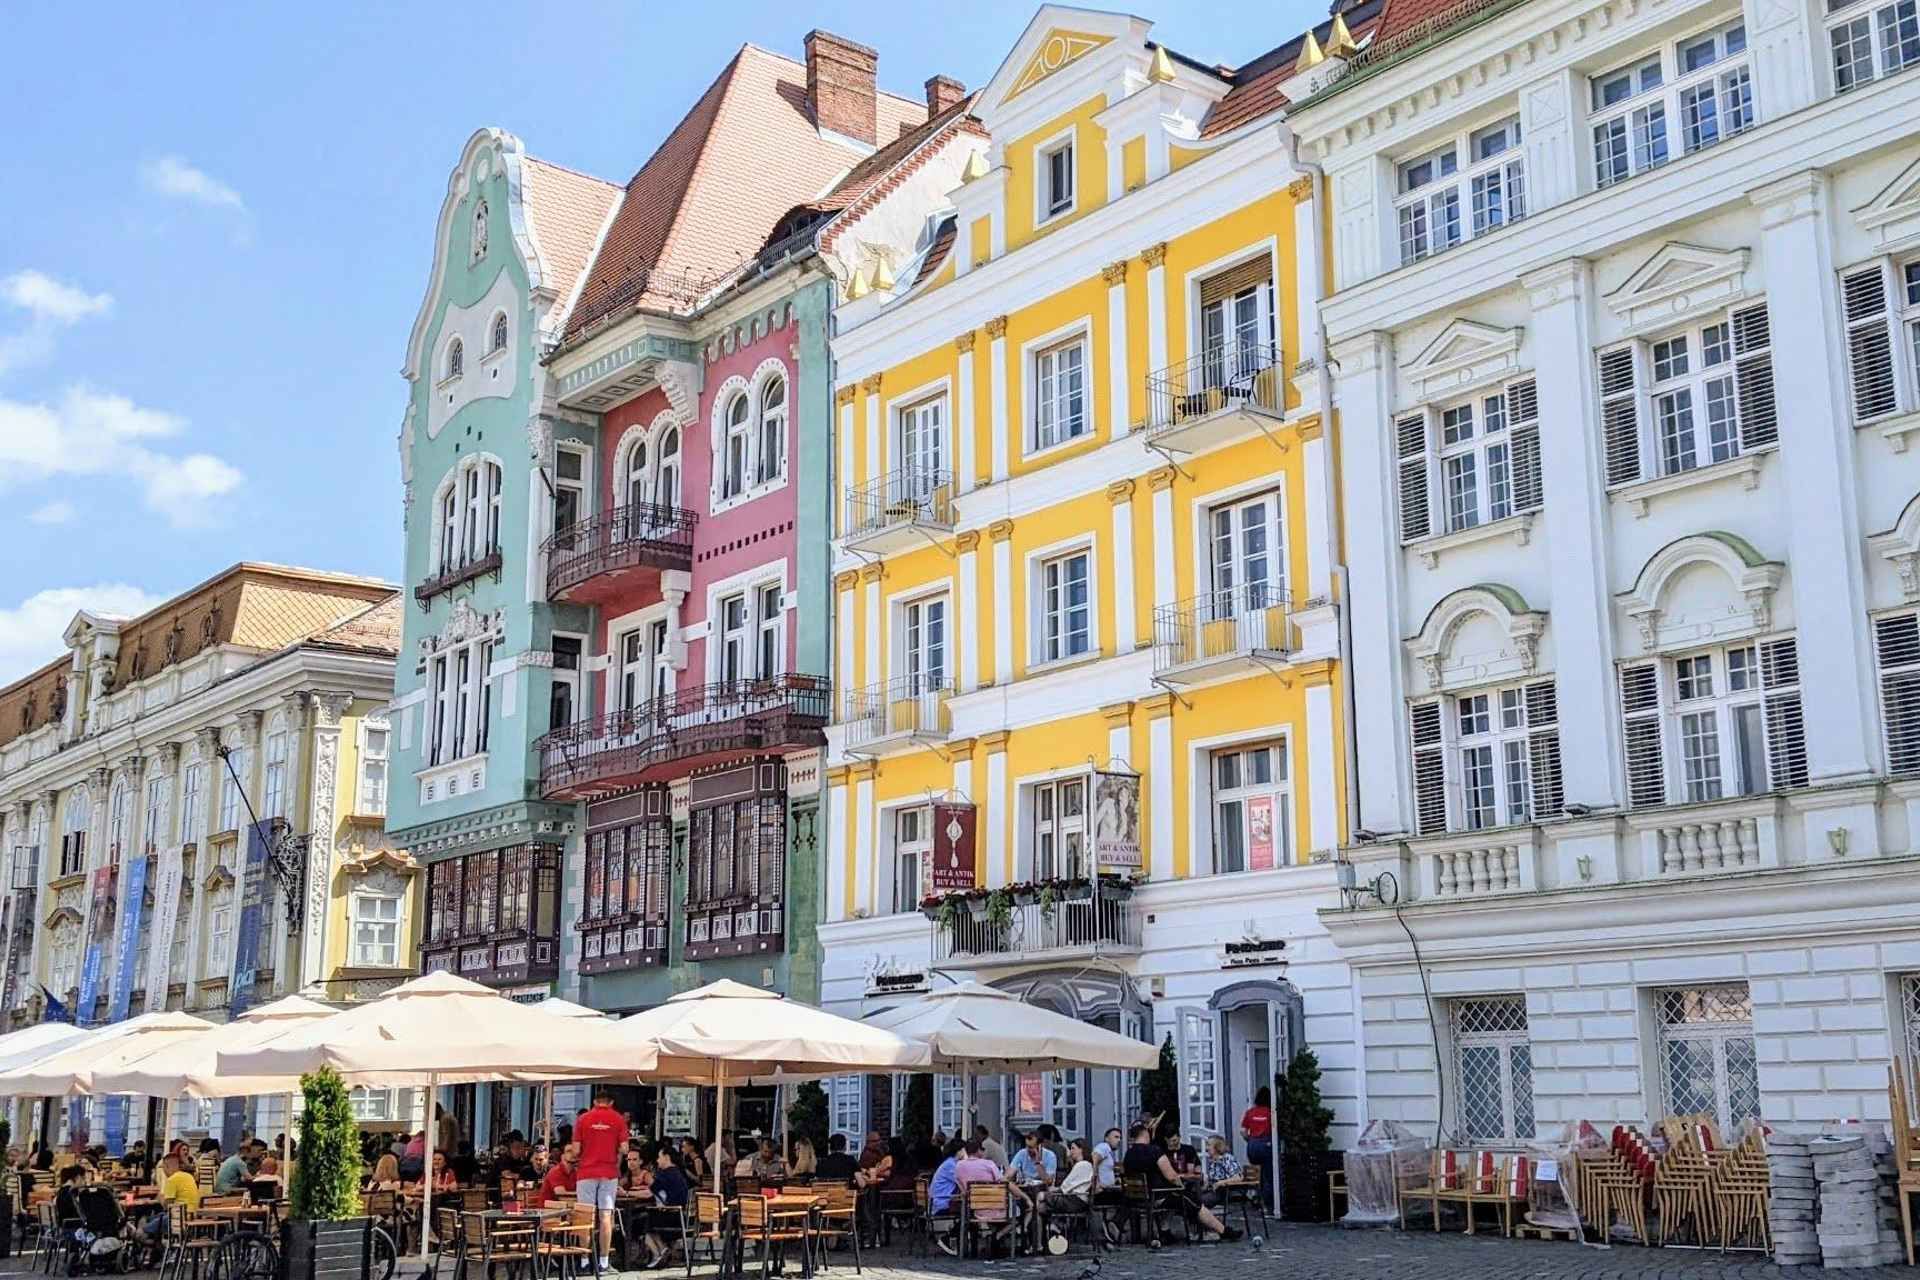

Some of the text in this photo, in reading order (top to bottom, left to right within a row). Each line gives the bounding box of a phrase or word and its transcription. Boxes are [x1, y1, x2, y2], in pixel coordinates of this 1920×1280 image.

[955, 870, 974, 878] ANTIK
[936, 878, 949, 886] BUY
[956, 879, 972, 887] SELL
